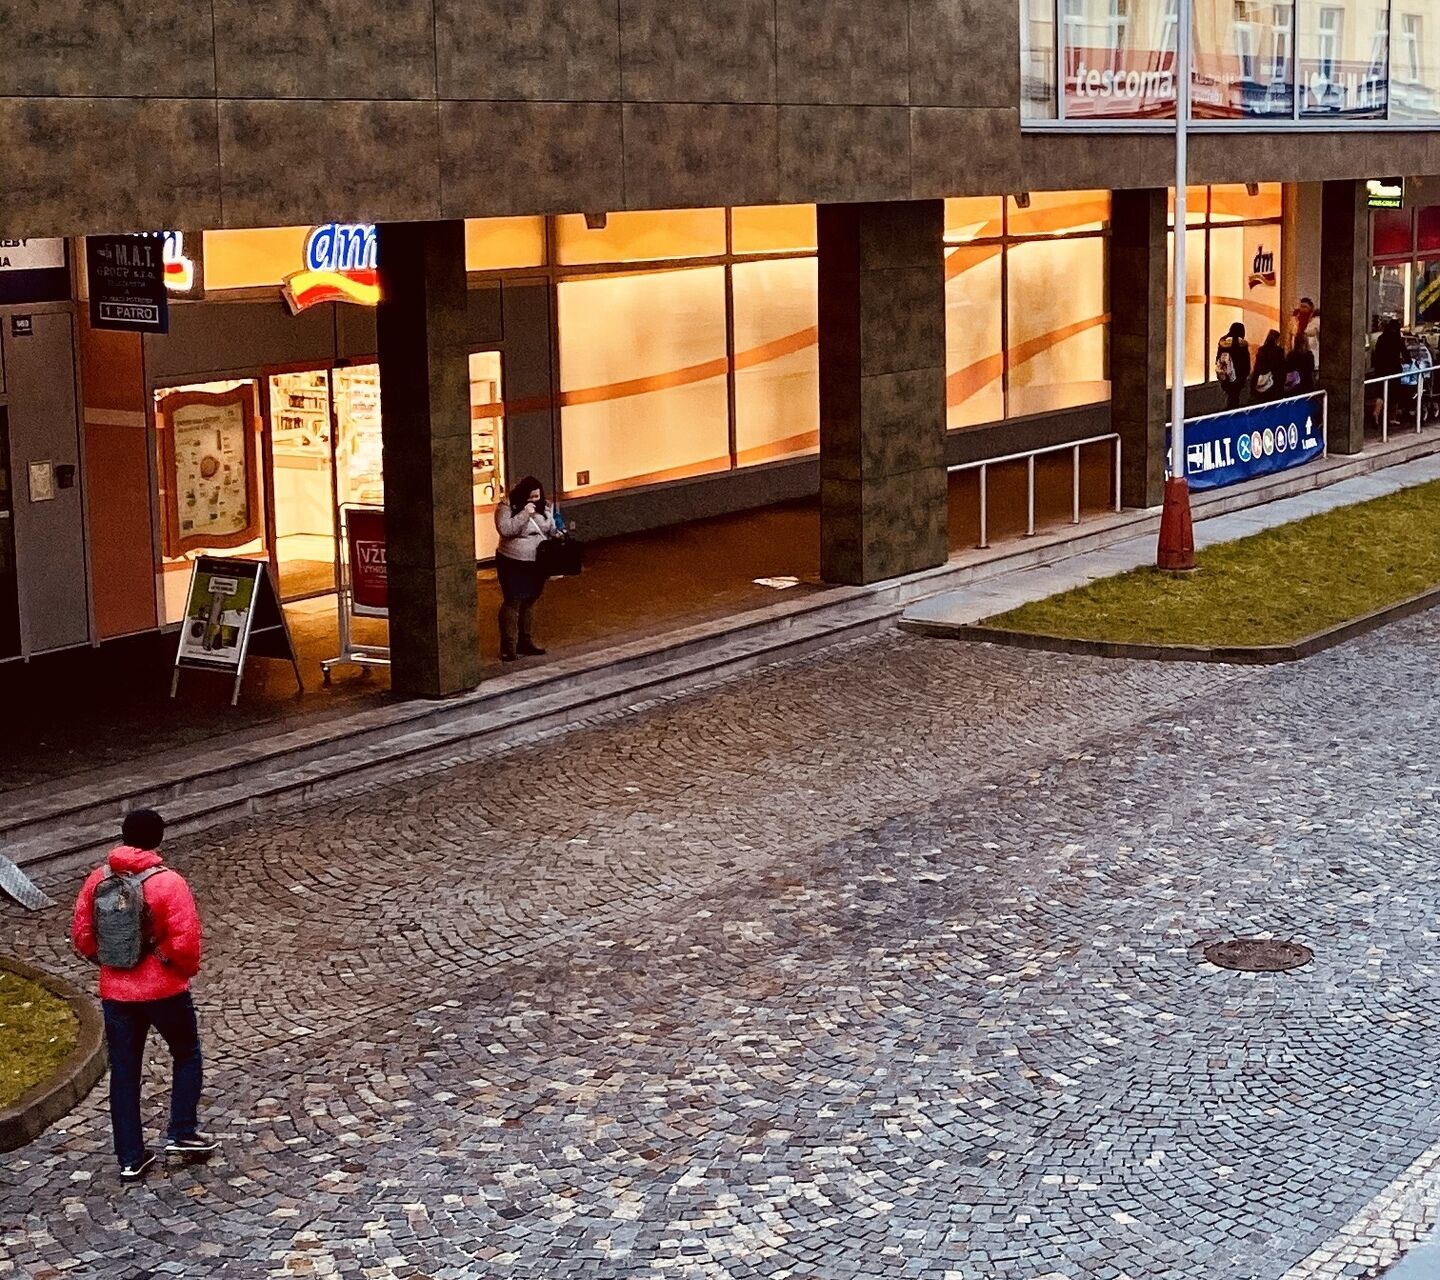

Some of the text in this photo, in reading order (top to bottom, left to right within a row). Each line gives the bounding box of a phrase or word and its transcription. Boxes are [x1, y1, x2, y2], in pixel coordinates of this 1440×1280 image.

[115, 243, 155, 268] M.A.T.
[1253, 243, 1274, 273] dm
[105, 306, 152, 320] 1 PATRO
[1203, 437, 1235, 471] M.A.T.
